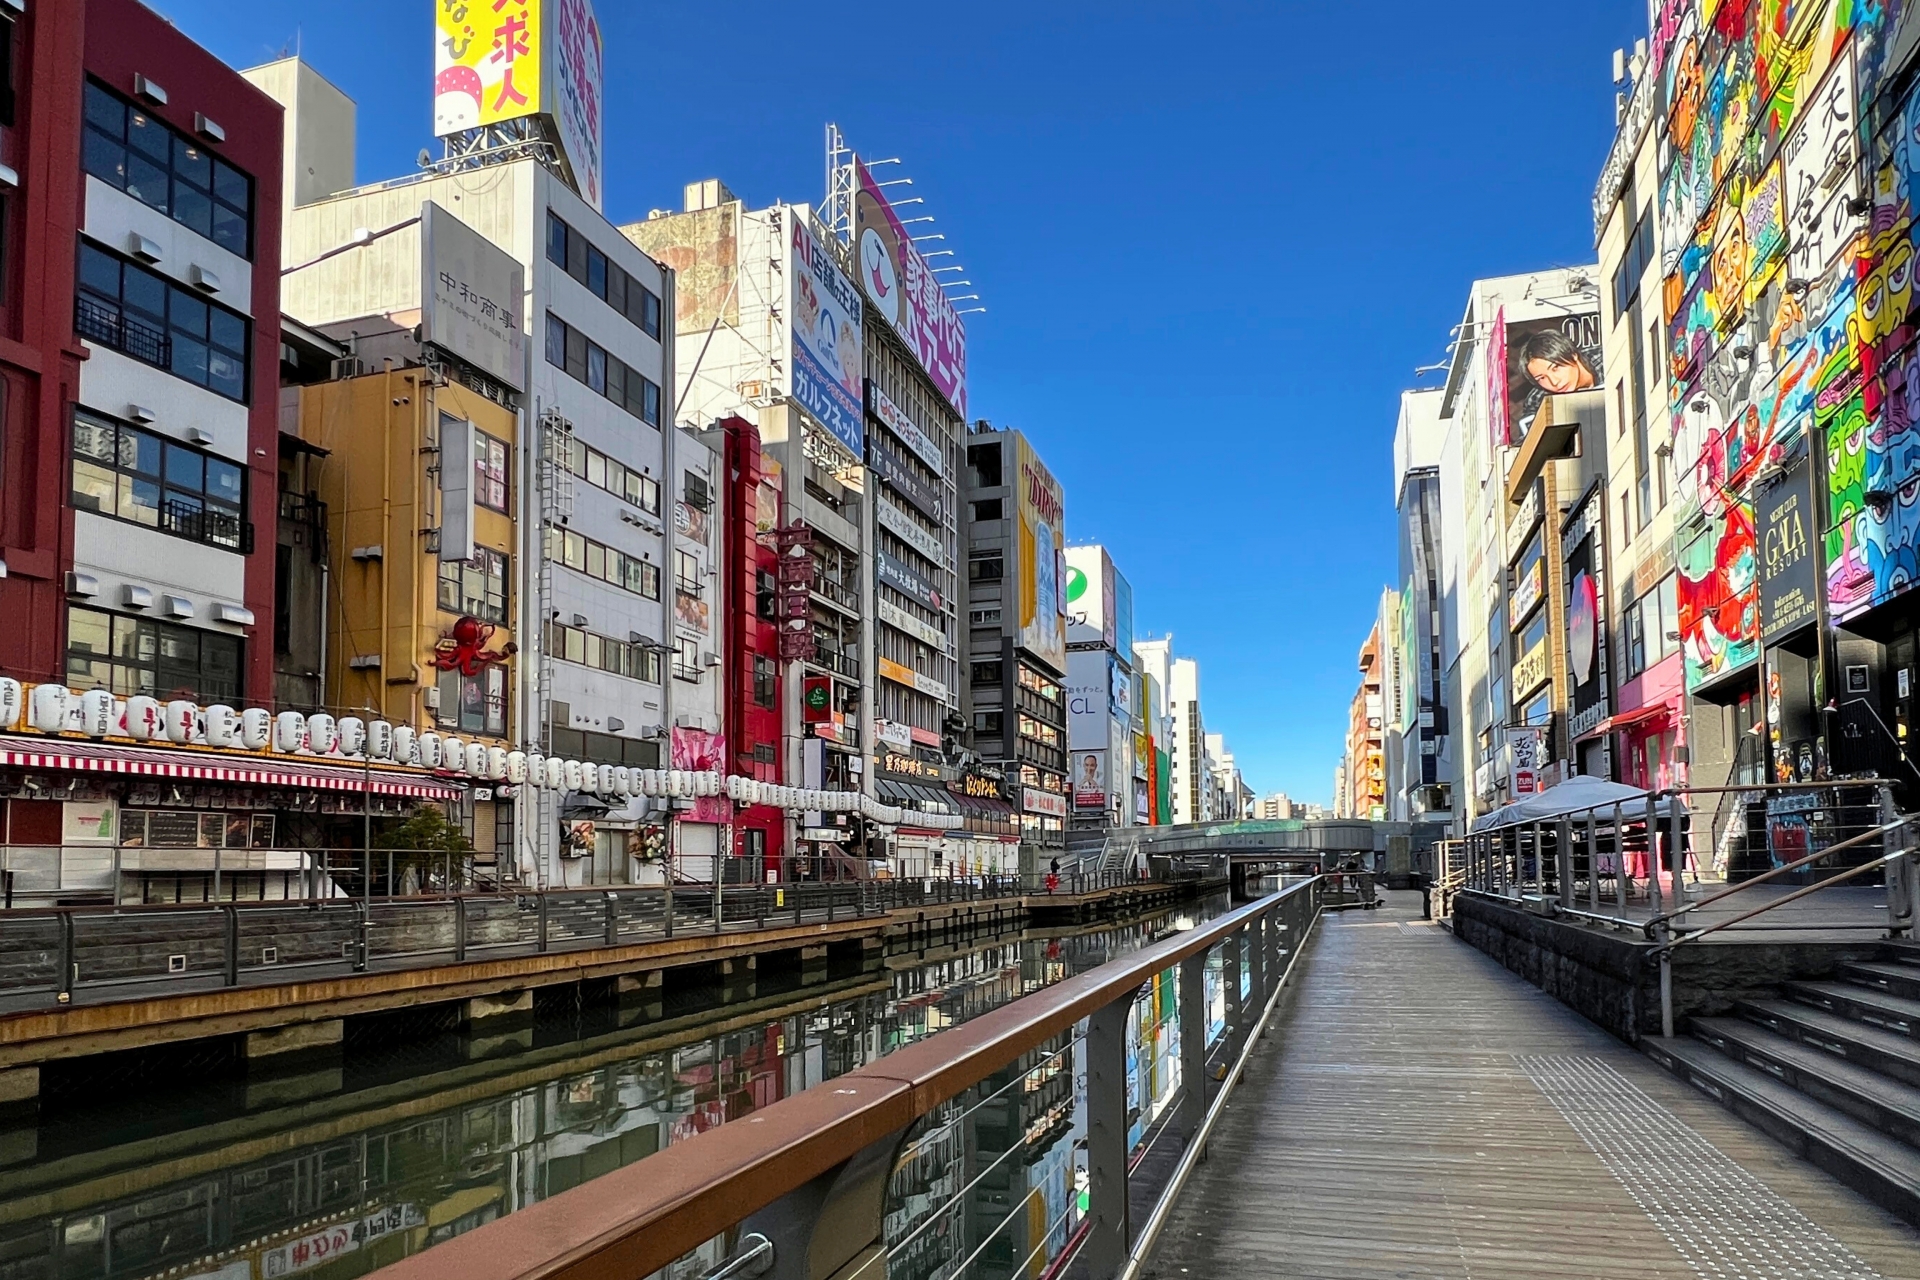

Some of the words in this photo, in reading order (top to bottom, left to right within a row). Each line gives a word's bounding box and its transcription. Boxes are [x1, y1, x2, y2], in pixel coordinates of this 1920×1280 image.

[490, 0, 529, 112] 求人
[440, 271, 516, 330] 中和商事
[792, 221, 861, 328] AI店舗の王様
[906, 238, 965, 362] 家事代行
[906, 296, 965, 417] ベアーズ
[795, 370, 859, 448] ガルフネット
[871, 445, 882, 466] 7F
[1765, 509, 1806, 566] GALA
[1766, 542, 1807, 581] RESORT
[881, 602, 908, 631] 白木屋
[1070, 698, 1096, 715] CL
[885, 754, 922, 778] 星乃珈琲店
[1517, 777, 1532, 786] ZUN
